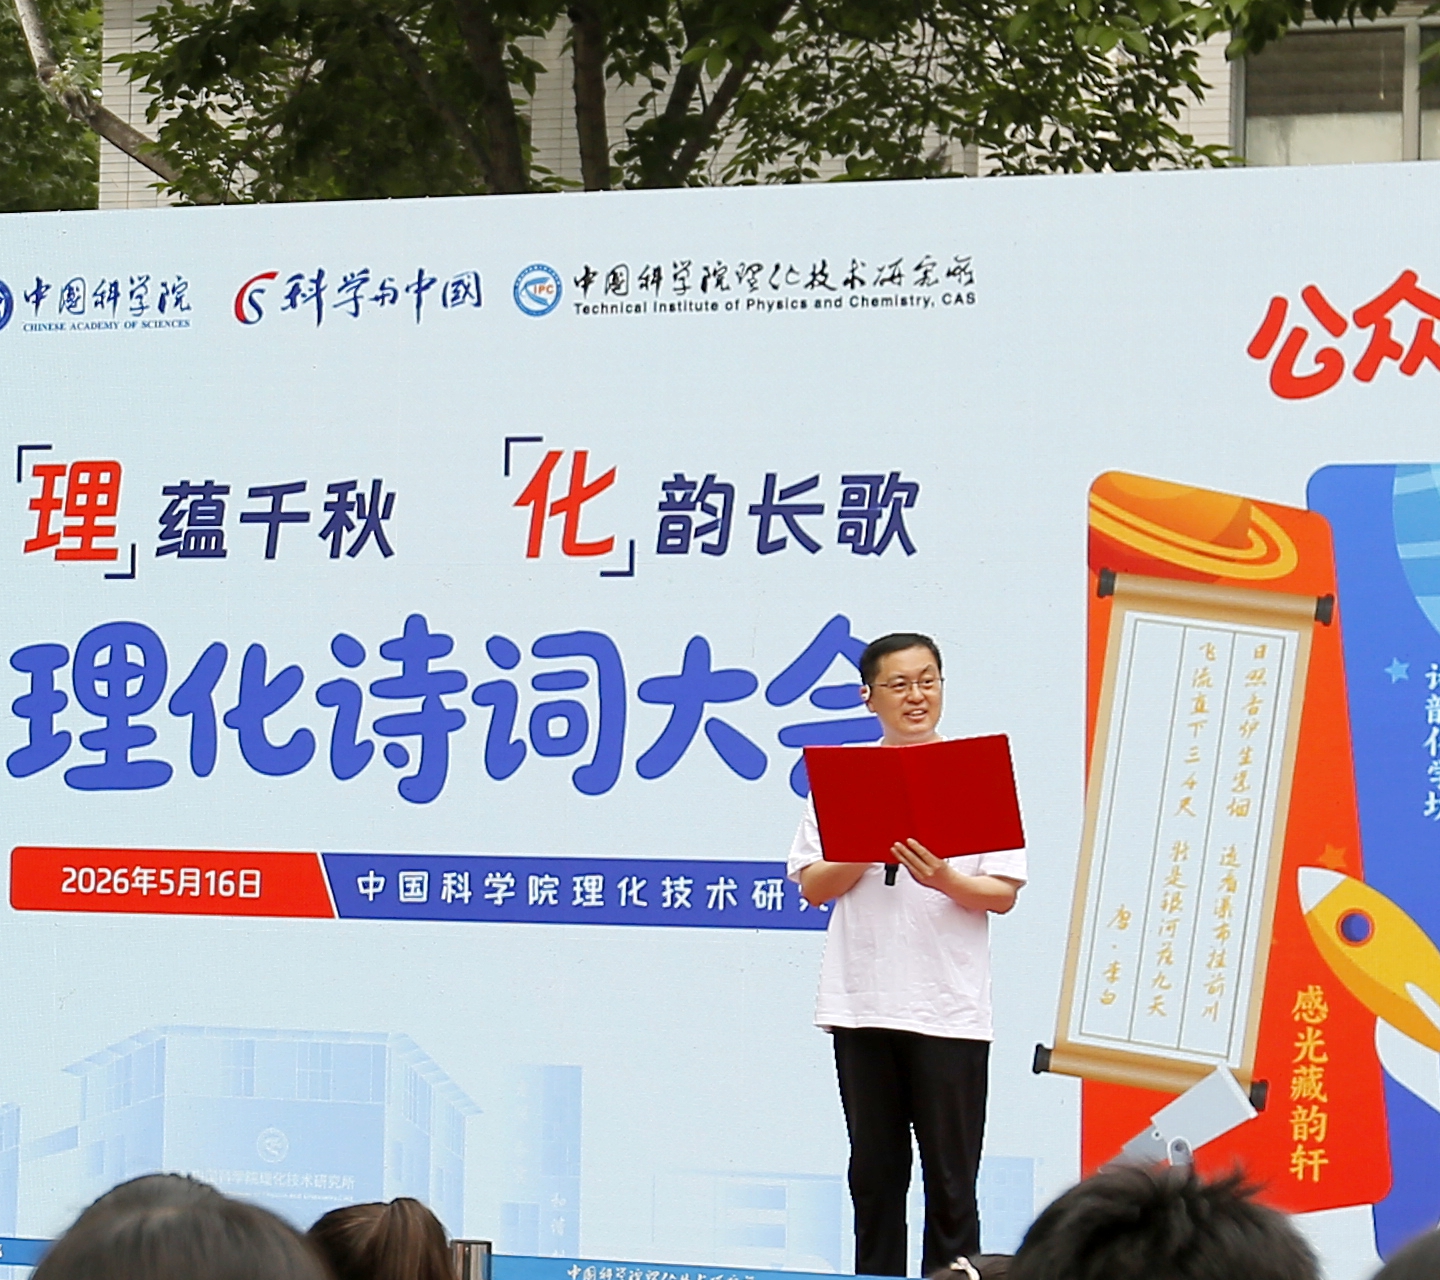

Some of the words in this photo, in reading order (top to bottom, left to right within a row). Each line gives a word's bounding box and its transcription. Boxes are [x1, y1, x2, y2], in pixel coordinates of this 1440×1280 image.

[22, 274, 191, 317] 中国科学院
[281, 267, 483, 327] 科学与中国
[573, 255, 976, 297] 中国科学院理化技术研究所
[573, 302, 647, 316] Technical
[653, 300, 719, 313] Institute
[725, 299, 740, 311] of
[746, 297, 808, 313] Physics
[813, 296, 843, 309] and
[849, 294, 936, 310] Chemistry,
[942, 292, 976, 306] CAS
[22, 321, 67, 332] CHINESE
[69, 321, 121, 332] ACADEMY
[123, 320, 139, 330] OF
[141, 319, 191, 330] SCIENCES
[60, 866, 263, 900] 2026年5月16日
[1289, 985, 1330, 1183] 感光藏韵轩
